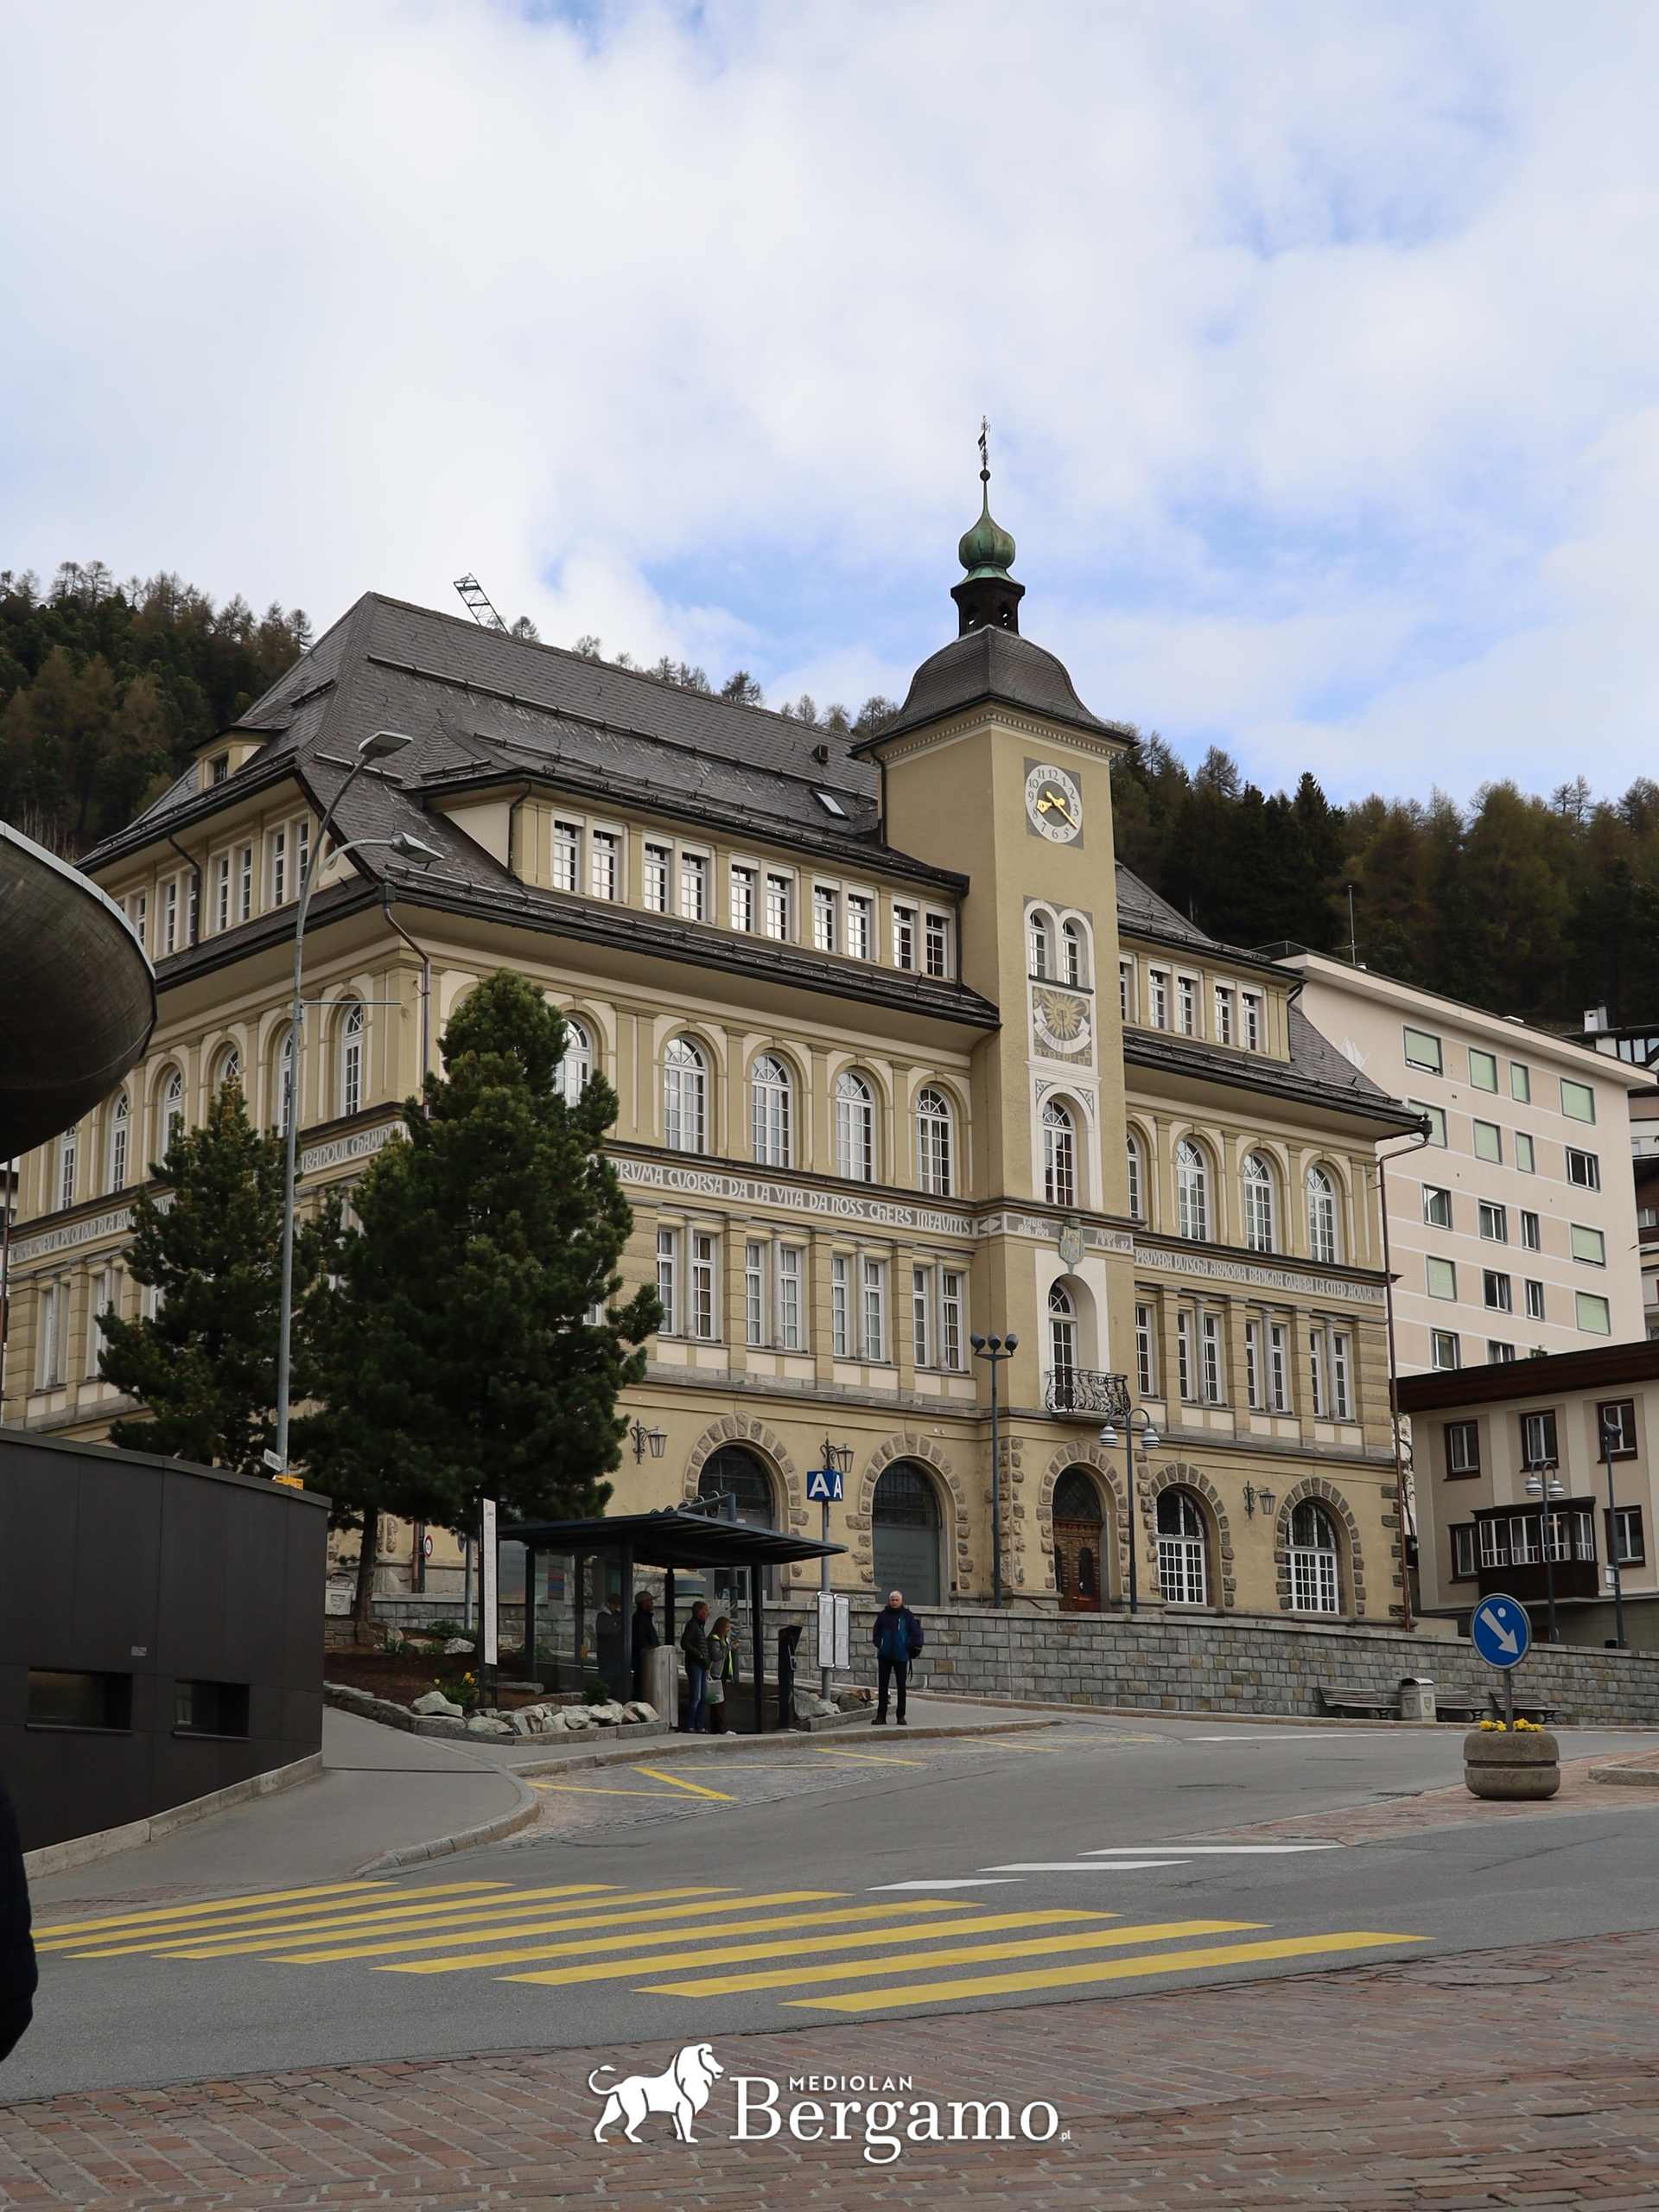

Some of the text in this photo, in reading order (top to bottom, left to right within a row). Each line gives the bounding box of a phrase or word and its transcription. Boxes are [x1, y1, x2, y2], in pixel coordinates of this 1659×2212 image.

[1036, 769, 1045, 779] 11
[1049, 769, 1058, 781] 12
[1028, 778, 1039, 789] 10
[1028, 791, 1034, 802] 9
[1073, 804, 1079, 817] 3
[1052, 829, 1058, 839] 6
[729, 1179, 747, 1198] DA
[754, 1184, 770, 1202] LA
[775, 1186, 804, 1208] VITA
[809, 1194, 827, 1211] DA
[809, 1472, 830, 1497] A
[833, 1474, 842, 1499] A
